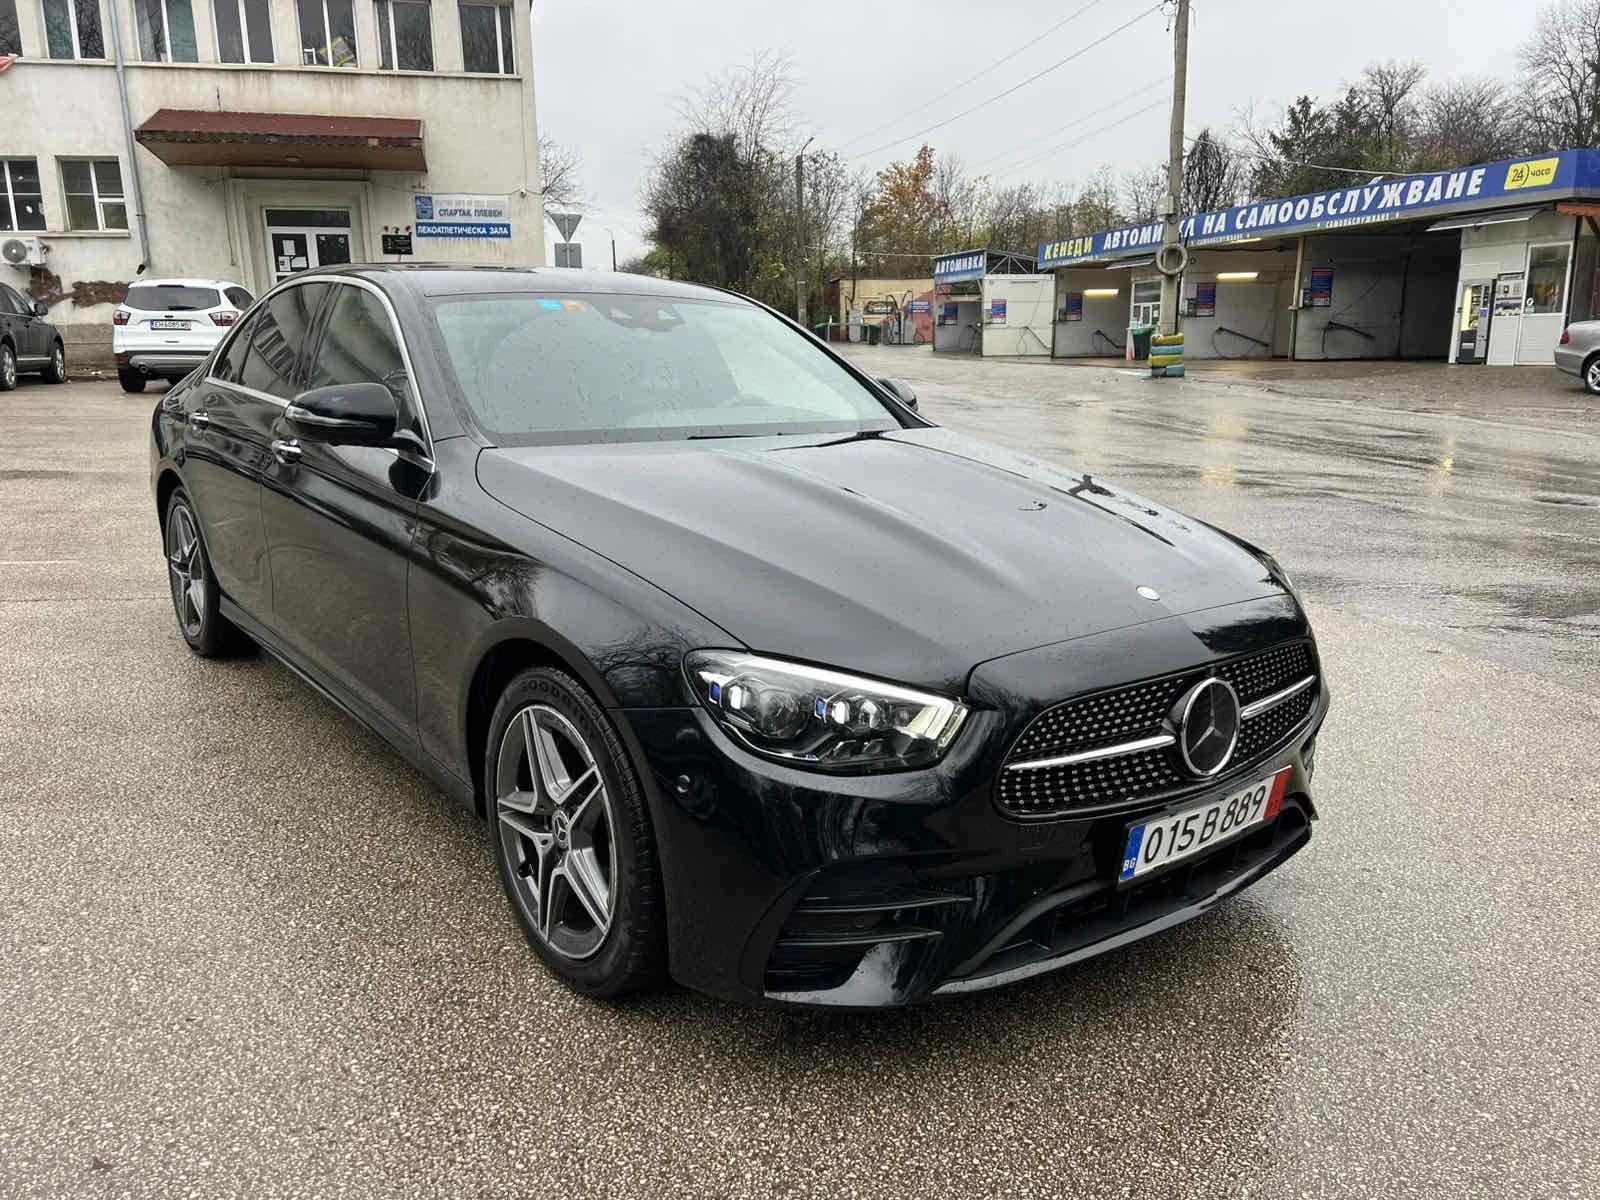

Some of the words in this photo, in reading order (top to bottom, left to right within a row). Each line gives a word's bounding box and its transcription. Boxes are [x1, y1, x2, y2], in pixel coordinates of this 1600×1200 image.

[1511, 167, 1524, 183] 24
[1530, 167, 1552, 177] часа
[438, 208, 472, 217] СПАРТАК
[474, 208, 503, 218] ПЛЕВЕН
[1043, 235, 1093, 260] КЕНЕДИ
[1103, 217, 1196, 251] АВТОМИКА
[1202, 212, 1227, 235] НА
[1235, 167, 1487, 230] САМООБСЛУЖВАНЕ
[489, 225, 508, 235] ЗАЛА
[935, 254, 984, 273] АВТОМИВКА
[1144, 784, 1267, 864] 015B889
[1121, 857, 1137, 872] BG
